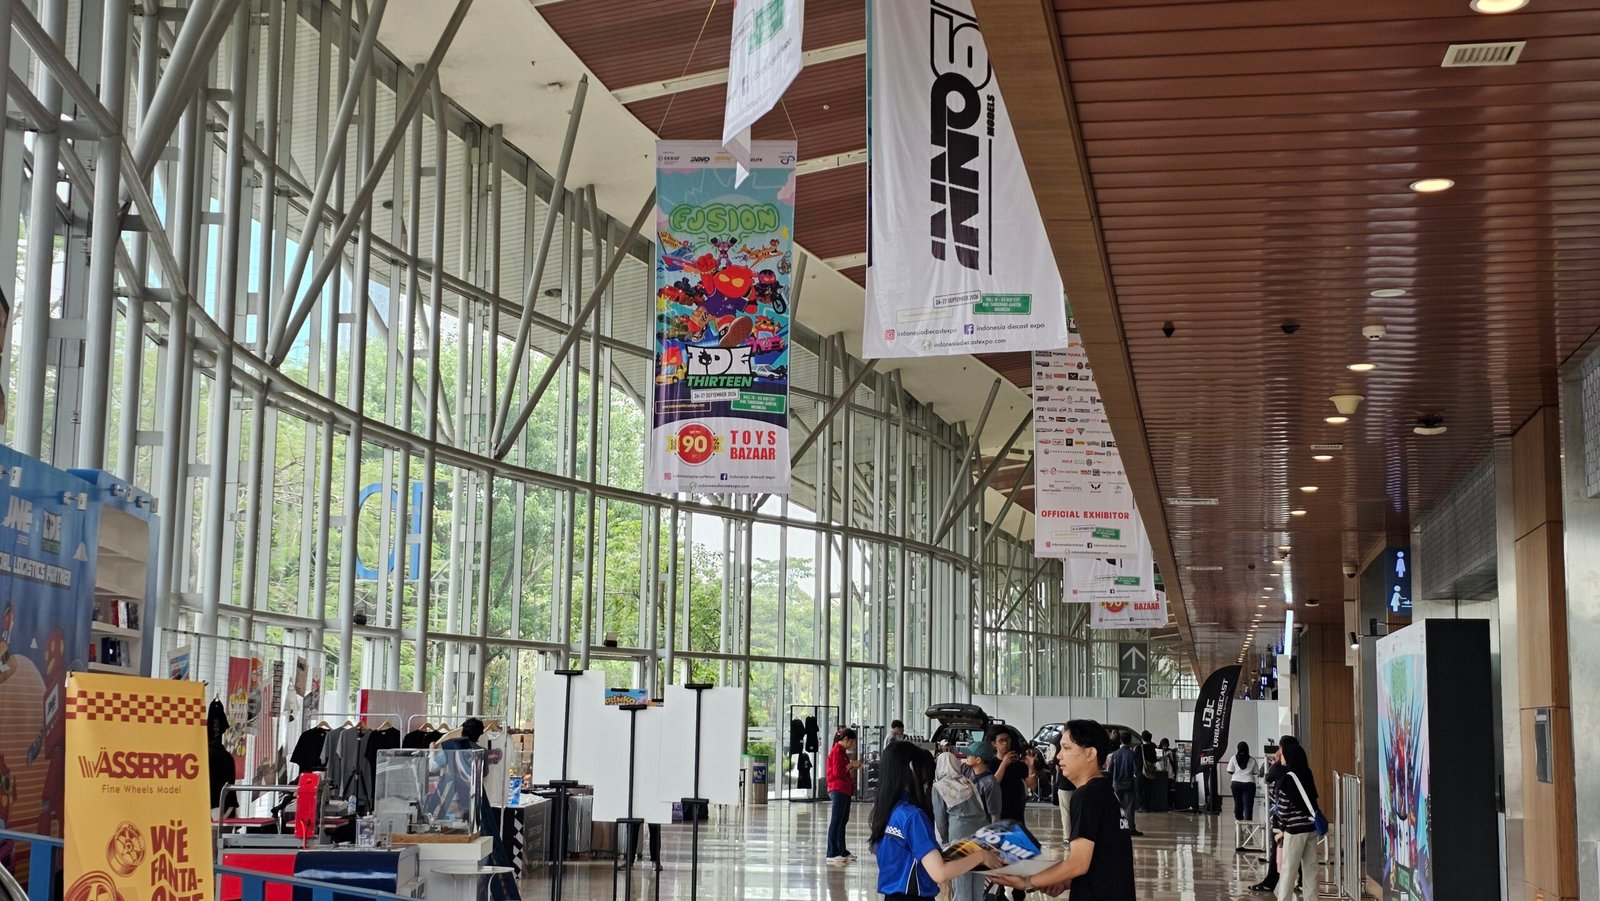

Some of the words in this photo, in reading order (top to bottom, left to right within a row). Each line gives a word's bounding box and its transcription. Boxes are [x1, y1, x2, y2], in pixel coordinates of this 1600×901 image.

[986, 94, 995, 137] MODELS
[670, 205, 778, 233] FUSION
[948, 296, 969, 304] SEPTEMBER
[896, 328, 958, 337] indonesiadiecastexpo
[976, 324, 1006, 332] indonesia
[1007, 323, 1029, 331] diecast
[1029, 323, 1045, 331] expo
[933, 338, 1006, 348] indonesiadiecastexpo.com
[686, 375, 753, 388] THIRTEEN
[682, 435, 708, 453] 90
[730, 430, 776, 445] TOYS
[730, 447, 776, 460] BAZAAR
[2, 494, 33, 534] JNE
[1041, 510, 1080, 518] OFFICIAL
[1083, 511, 1130, 520] EXHIBITOR
[13, 555, 46, 581] LOGISTICS
[46, 564, 72, 587] PARTNER
[1134, 602, 1160, 611] BAZAAR
[1120, 678, 1148, 695] 7,8
[1216, 678, 1229, 717] DIECAST
[1212, 717, 1221, 748] URBAN
[101, 784, 120, 794] Fine
[123, 785, 154, 794] Wheels
[156, 785, 182, 794] Model
